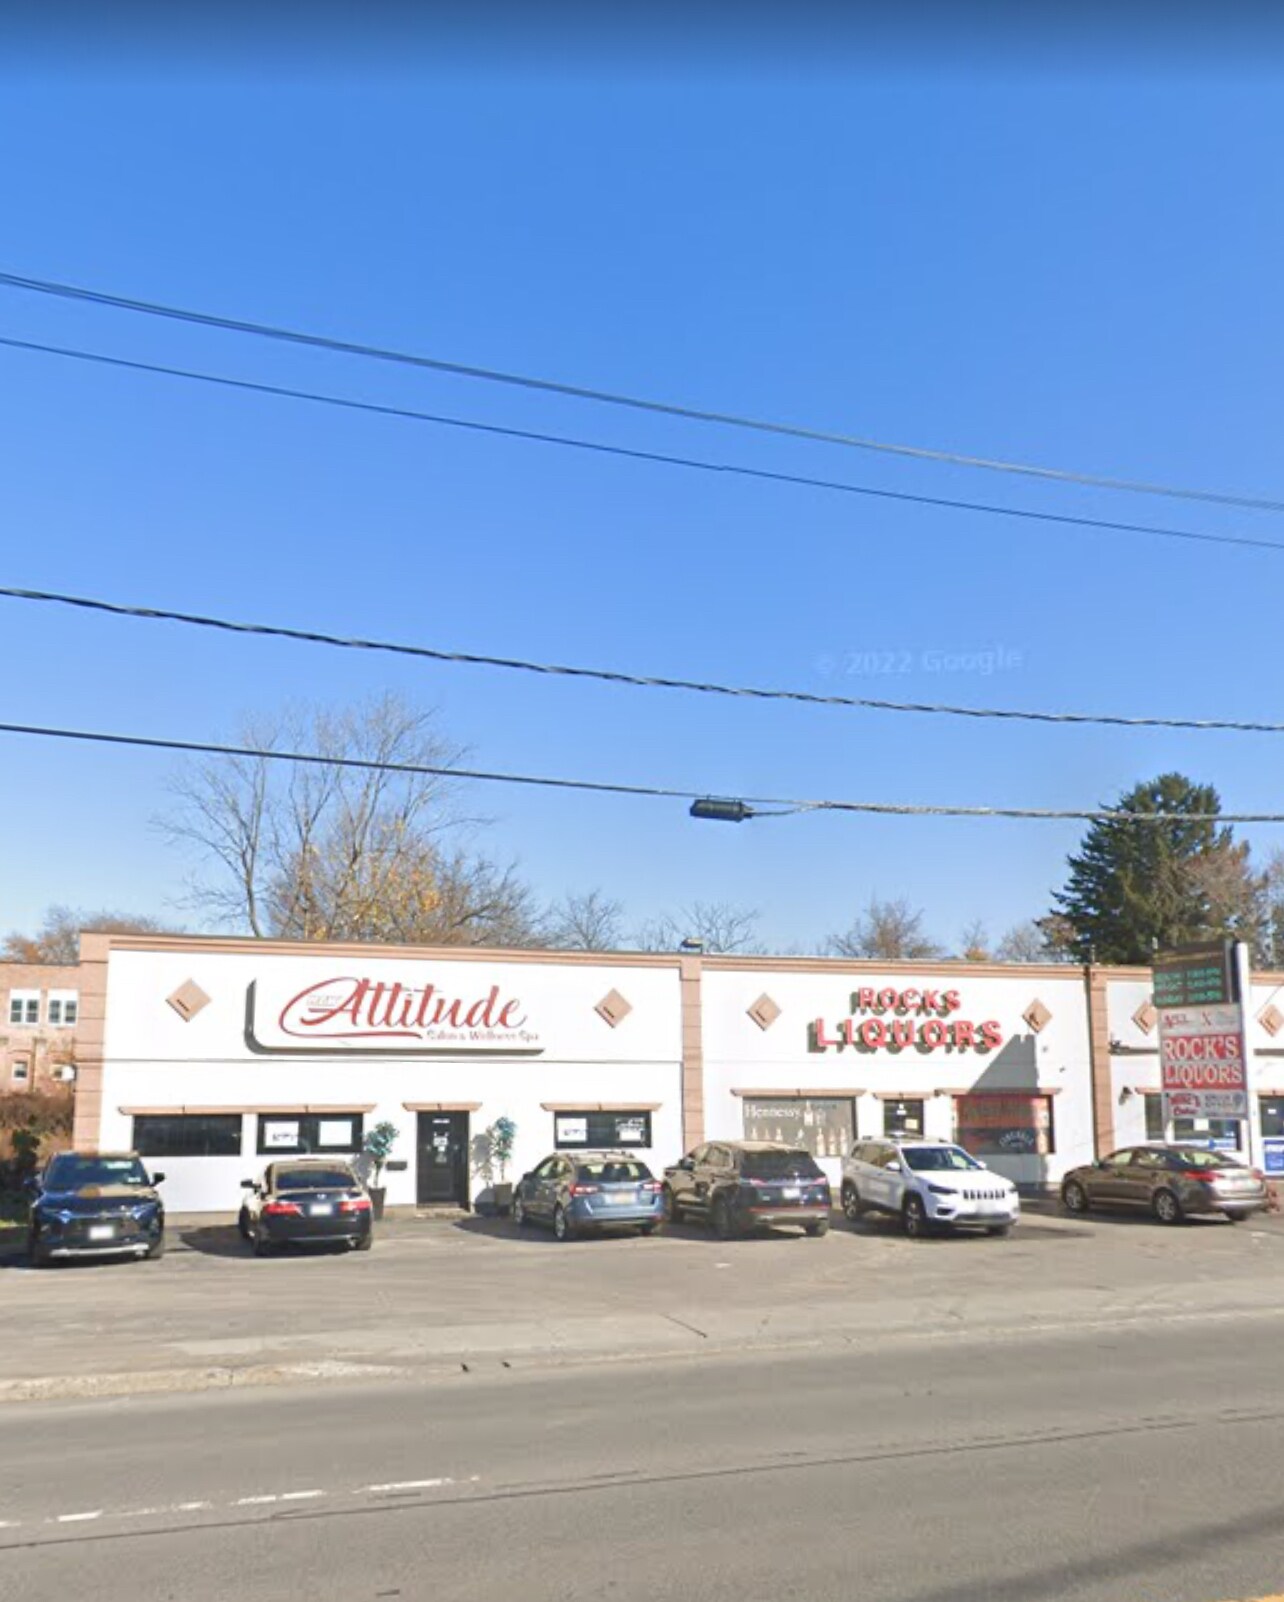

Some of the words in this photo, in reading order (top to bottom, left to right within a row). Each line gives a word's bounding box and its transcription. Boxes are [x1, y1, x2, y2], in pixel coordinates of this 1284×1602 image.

[279, 976, 527, 1039] Attitude
[856, 986, 961, 1014] ROCKS
[811, 1018, 1004, 1051] LIQUORS
[1163, 1035, 1239, 1061] ROCK'S
[1164, 1062, 1243, 1088] LIQUORS
